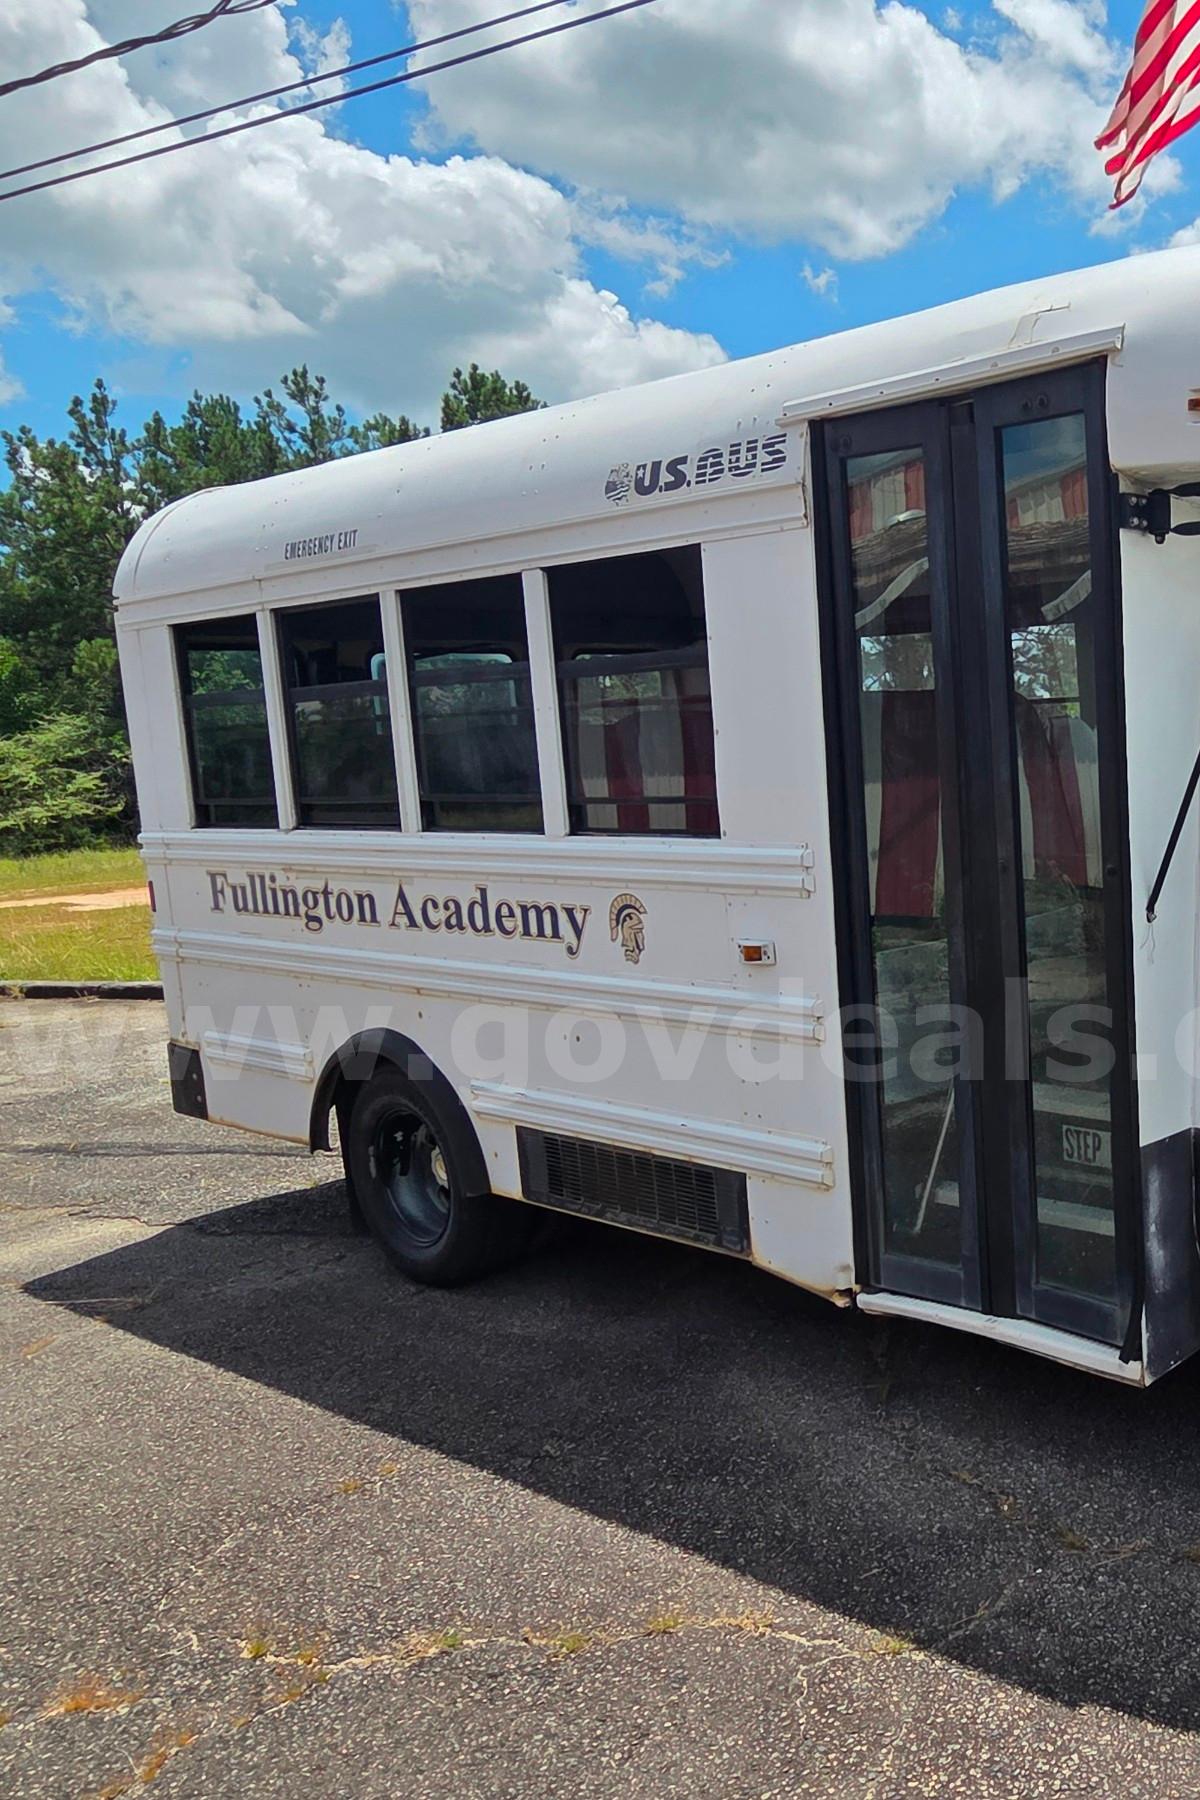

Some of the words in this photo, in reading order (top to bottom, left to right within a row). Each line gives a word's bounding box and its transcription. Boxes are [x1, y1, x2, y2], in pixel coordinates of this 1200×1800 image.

[284, 534, 335, 560] EMERGENCY
[338, 529, 358, 550] EXIT
[207, 870, 380, 935] Fullington
[389, 880, 591, 959] Academy
[1065, 1127, 1102, 1163] STEP
